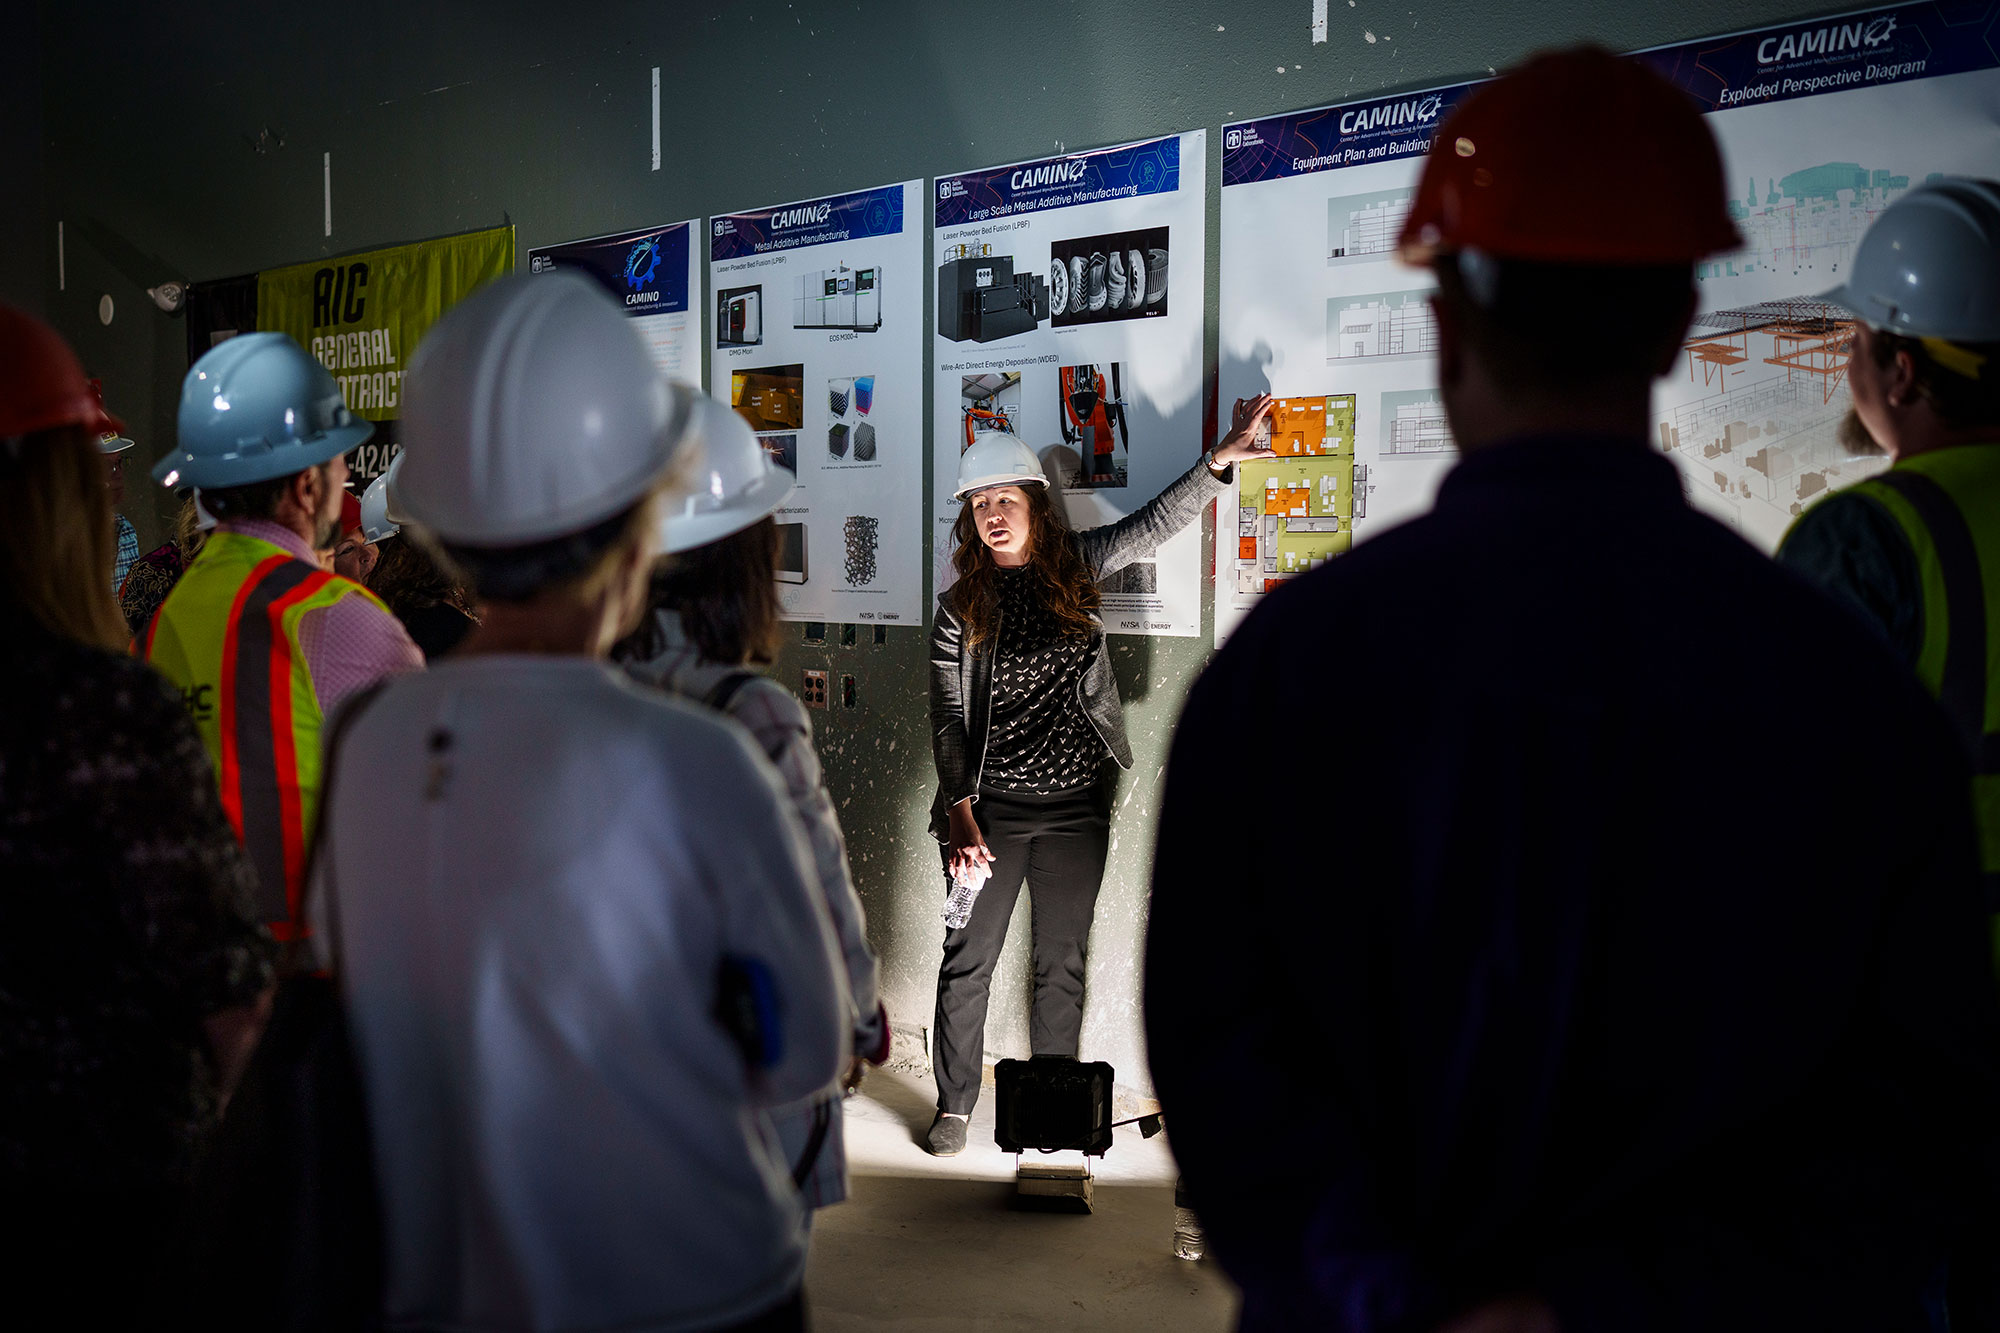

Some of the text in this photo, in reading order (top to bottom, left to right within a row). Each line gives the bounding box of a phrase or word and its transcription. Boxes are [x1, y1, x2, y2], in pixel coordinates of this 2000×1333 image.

[1720, 59, 1926, 104] Exploded Perspective Diagram
[1293, 151, 1342, 171] Equipment
[1344, 148, 1365, 162] Plan
[1368, 143, 1386, 158] and
[1389, 138, 1431, 155] Building
[969, 183, 1138, 221] Large Scale Metal Additive Manufacturing
[754, 229, 850, 252] Metal Additive Manufacturing
[942, 219, 1031, 240] Laser Powder Bed Fusion (LPBF)
[717, 265, 729, 273] Laser
[730, 262, 746, 271] Powder
[755, 258, 771, 267] Fusion
[771, 256, 787, 267] (LPBF)
[313, 262, 368, 328] AIC
[626, 291, 660, 304] CAMINO
[312, 328, 396, 370] GENERAL
[940, 354, 1060, 371] Wire-Arc Direct Energy Deposition (WDED)
[335, 369, 408, 410] NTRACT
